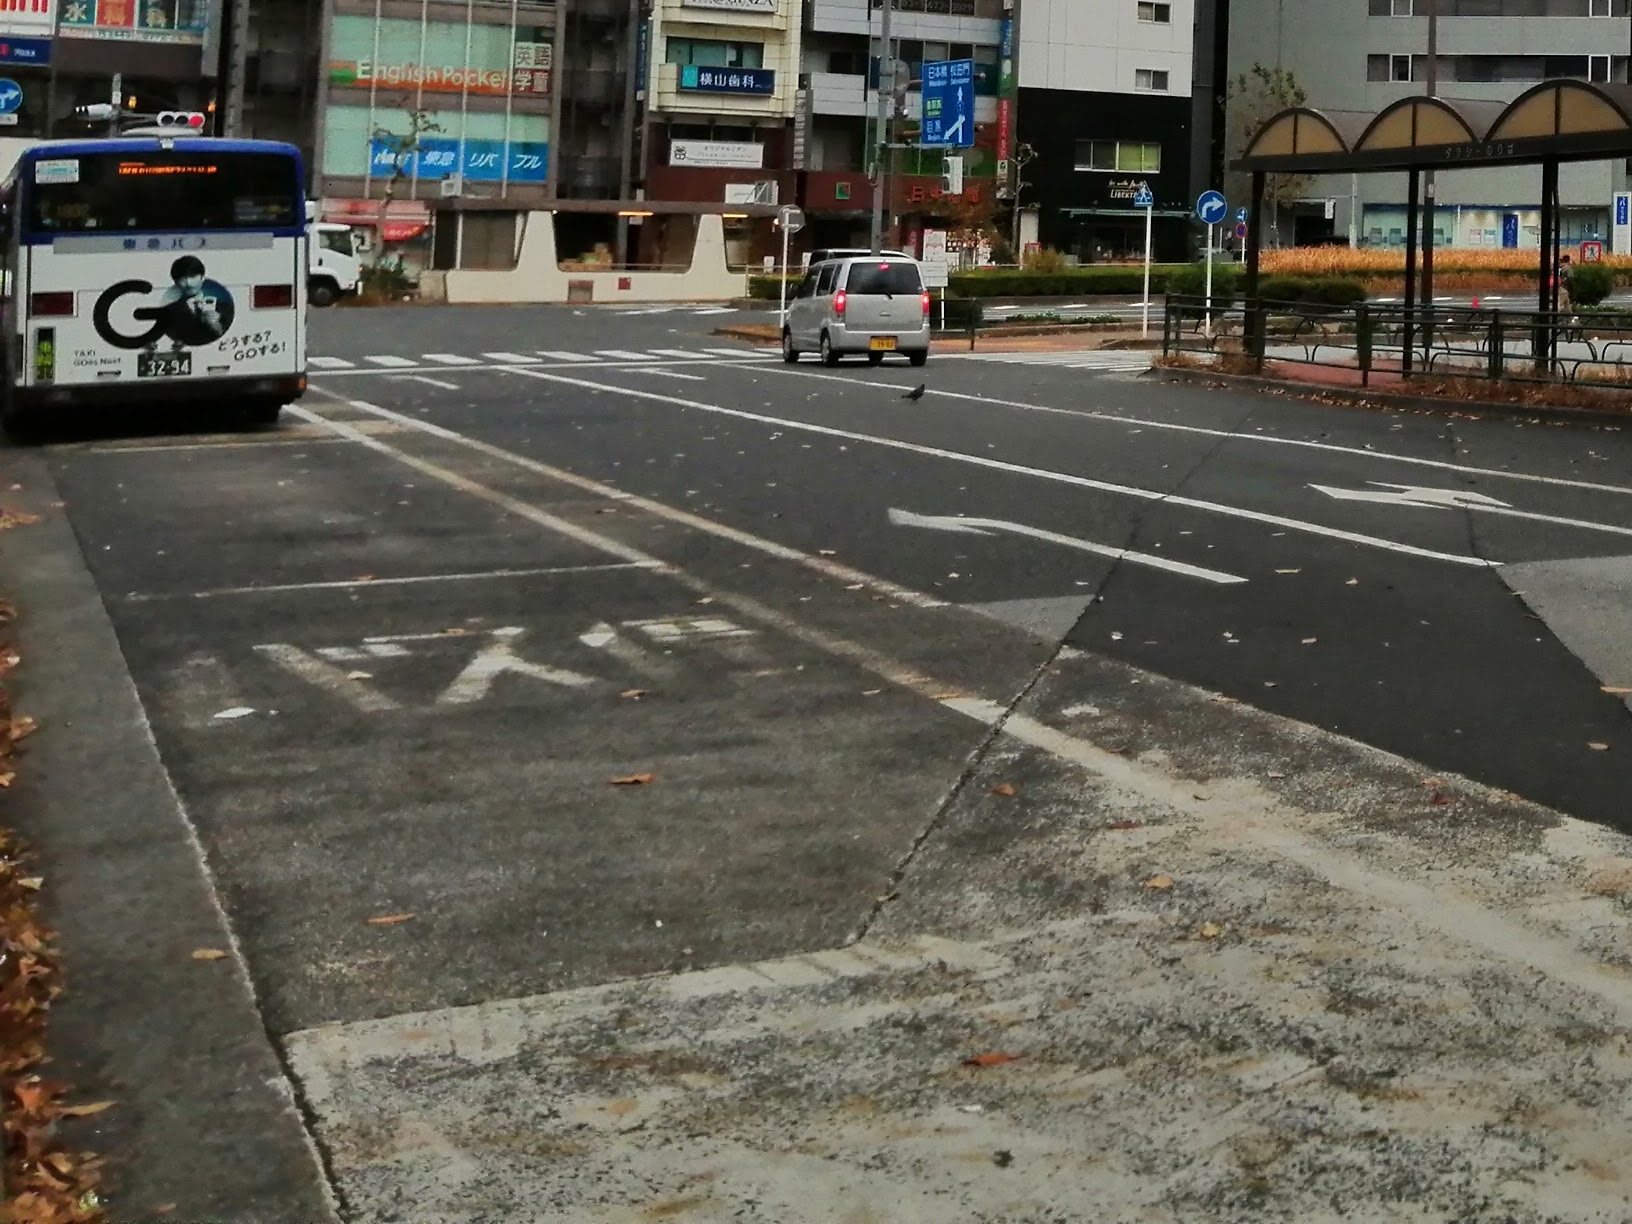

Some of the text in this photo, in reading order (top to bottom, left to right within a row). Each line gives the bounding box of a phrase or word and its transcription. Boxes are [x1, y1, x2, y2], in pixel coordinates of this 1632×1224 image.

[516, 45, 550, 66] 英語
[357, 59, 508, 89] English Pocket
[699, 71, 755, 88] 横山歯科
[423, 151, 542, 170] 東急リバブル
[218, 330, 272, 352] どうする?
[233, 341, 286, 362] GOする!
